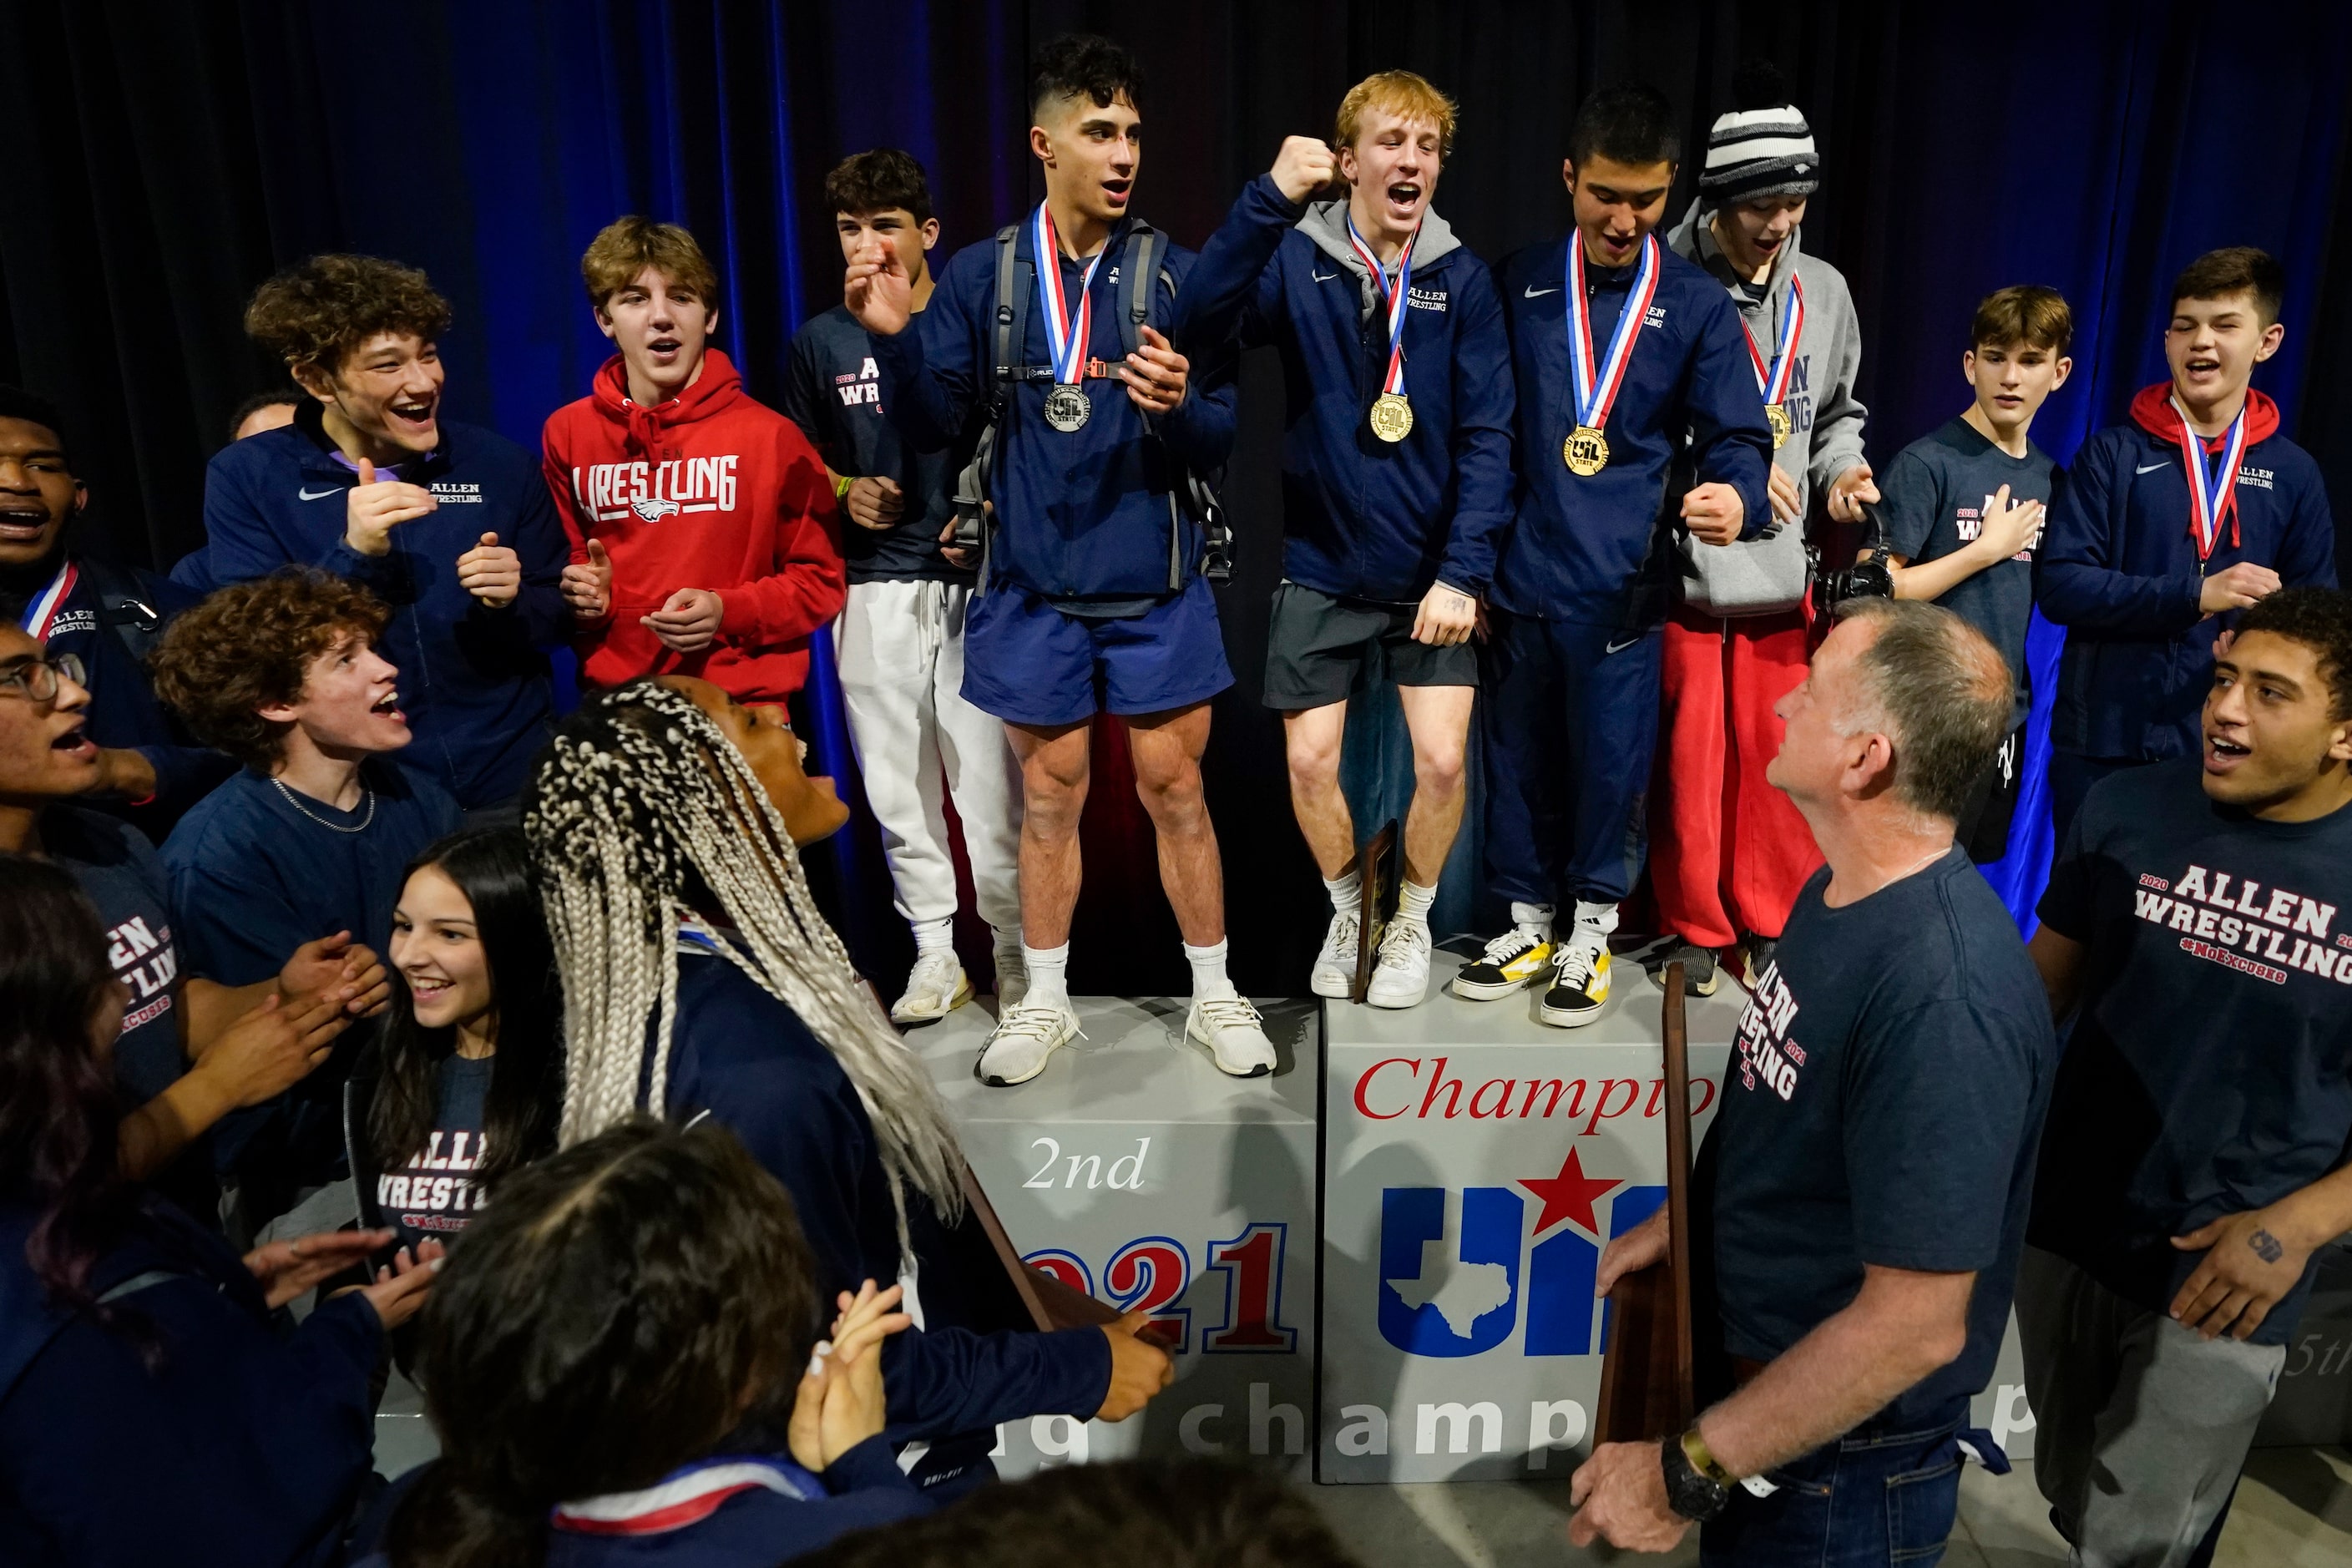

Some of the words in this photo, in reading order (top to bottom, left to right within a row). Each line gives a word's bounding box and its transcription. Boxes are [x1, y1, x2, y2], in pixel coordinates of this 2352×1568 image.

[1408, 286, 1447, 301] ALLEN
[1407, 297, 1447, 312] WRESTLING
[835, 373, 857, 384] 2020
[1053, 397, 1081, 417] UIL
[1378, 406, 1404, 428] UIL
[1382, 425, 1399, 433] STATE
[1573, 440, 1599, 462] UIL
[430, 483, 480, 493] ALLEN
[573, 454, 740, 523] WRESTLING
[1956, 508, 1979, 518] 2020
[51, 609, 95, 628] LLEN
[2138, 873, 2169, 891] 2020
[2173, 863, 2336, 940] ALLEN
[2134, 888, 2352, 985] WRESTLING
[1783, 1037, 1808, 1068] 2021
[1021, 1136, 1151, 1190] 2nd
